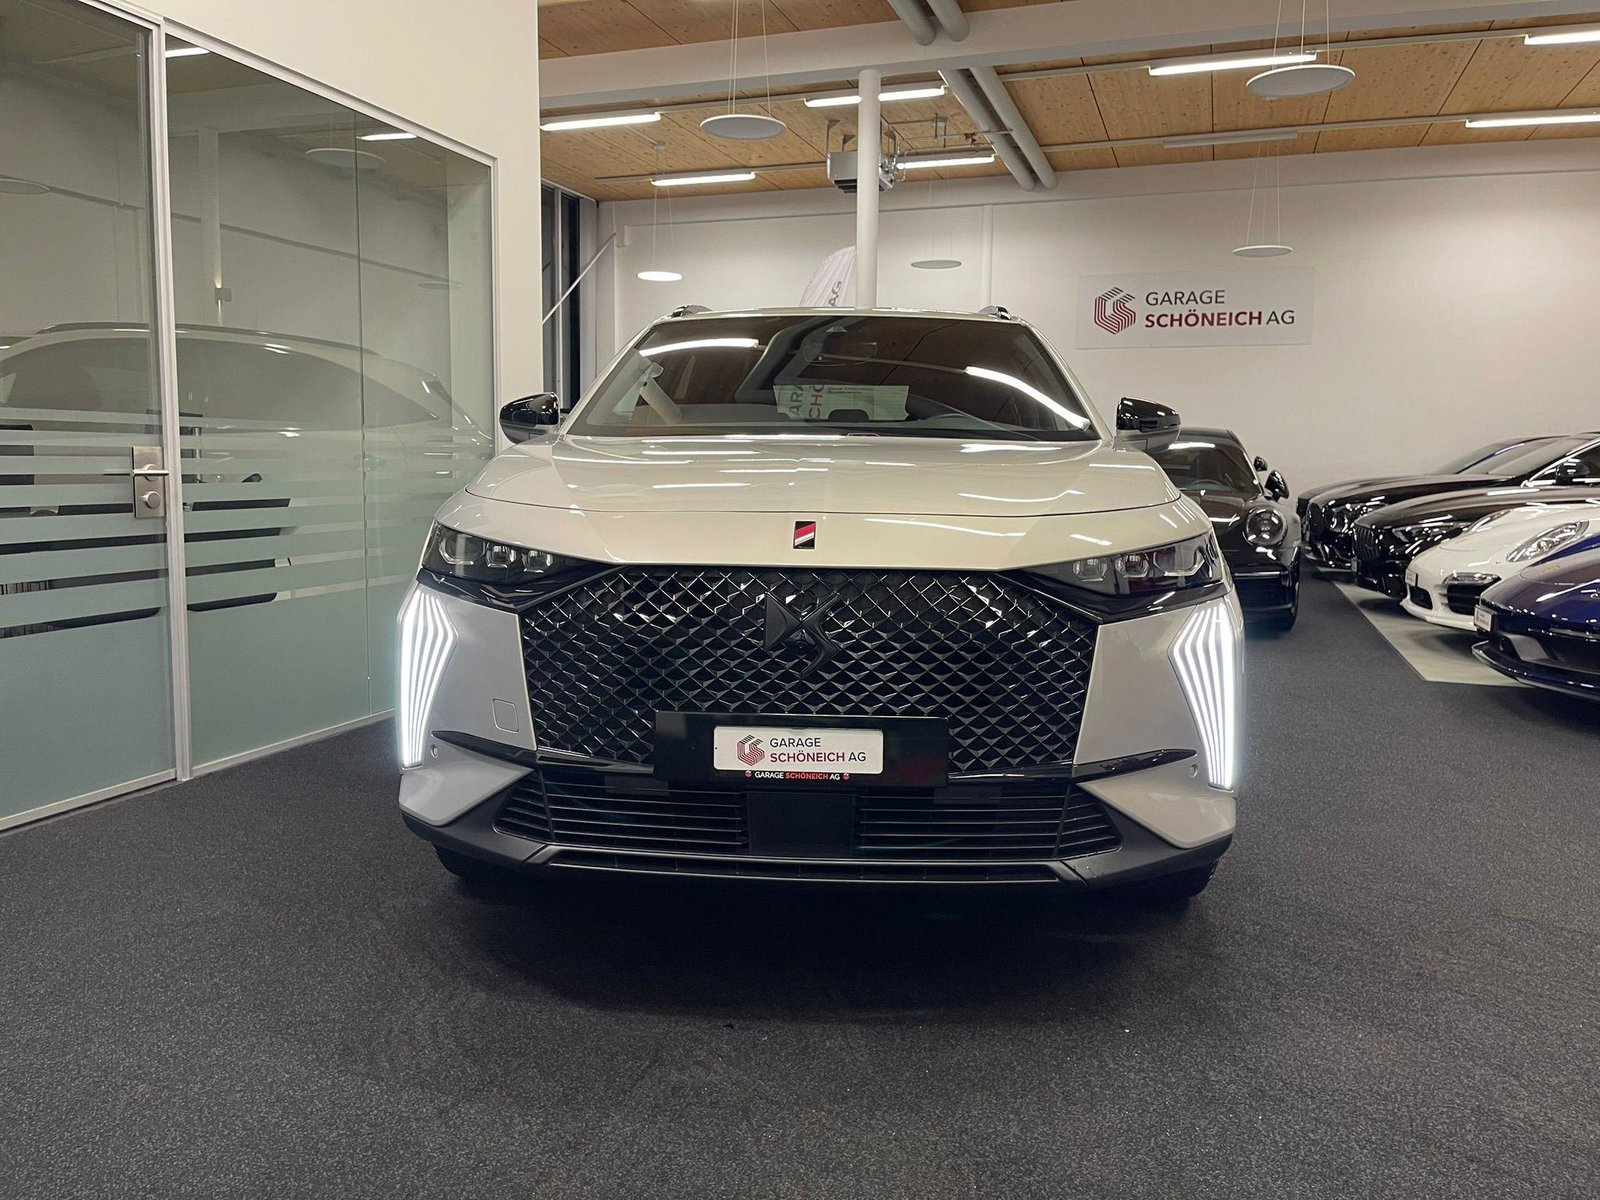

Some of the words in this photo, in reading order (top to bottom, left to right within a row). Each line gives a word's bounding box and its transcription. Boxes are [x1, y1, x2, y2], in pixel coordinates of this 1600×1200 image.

[1145, 290, 1225, 305] GARAGE
[1145, 309, 1262, 328] SCHÖNEICH
[1266, 310, 1295, 325] AG
[770, 737, 821, 748] GARAGE
[770, 750, 845, 762] SCHÖNEICH
[848, 752, 866, 762] AG
